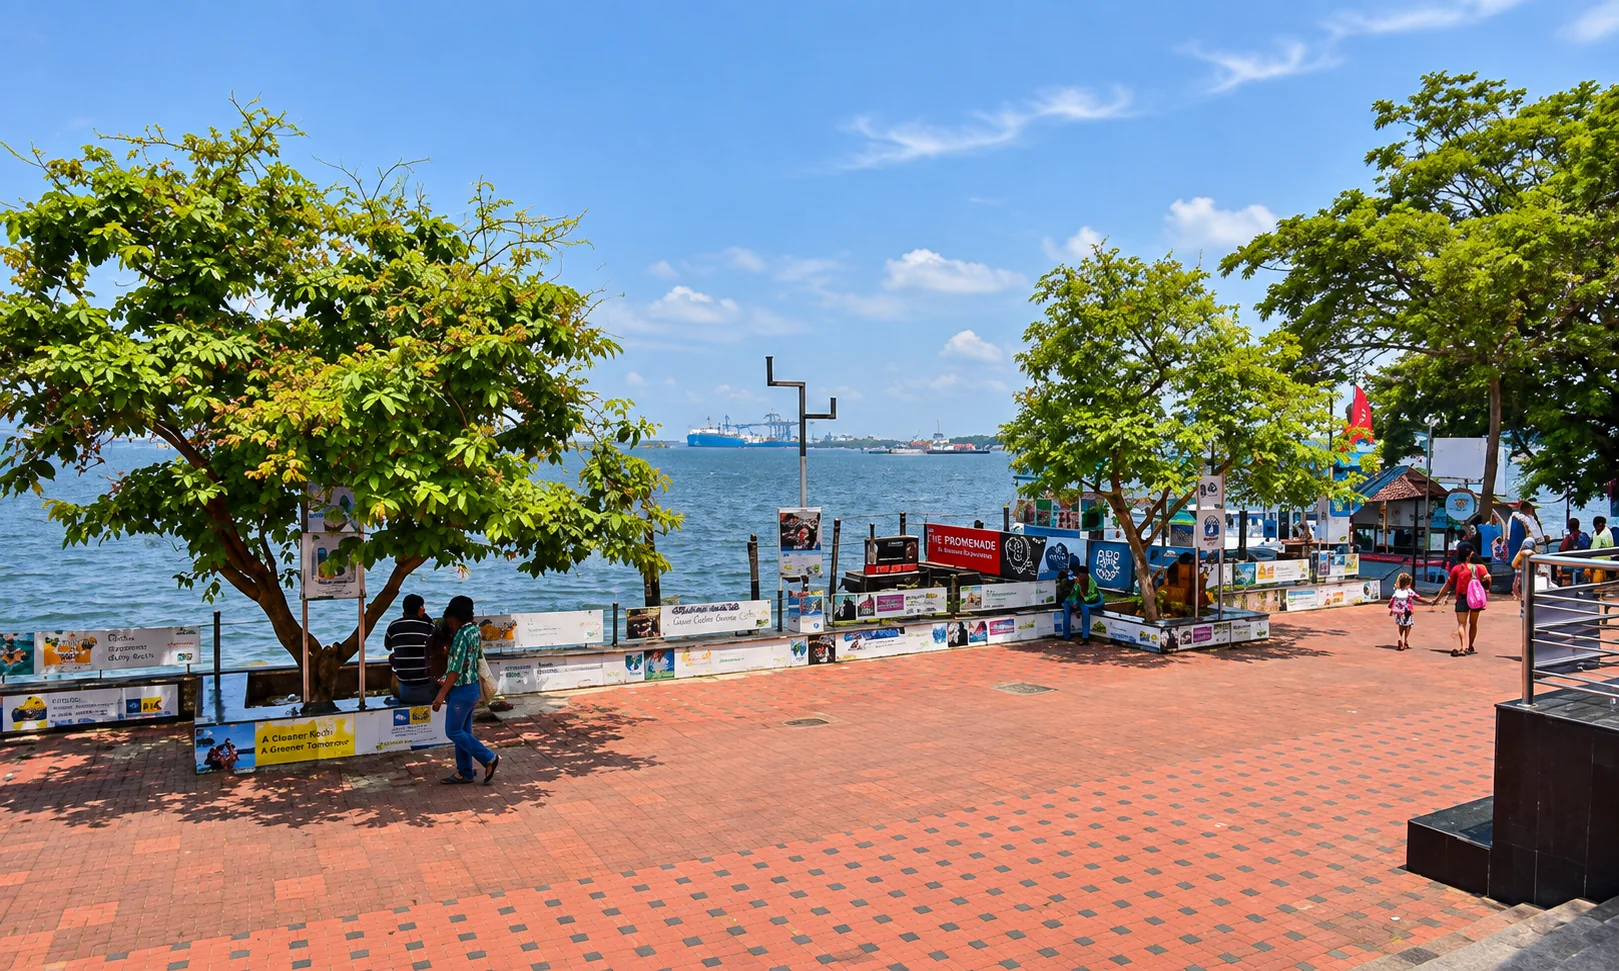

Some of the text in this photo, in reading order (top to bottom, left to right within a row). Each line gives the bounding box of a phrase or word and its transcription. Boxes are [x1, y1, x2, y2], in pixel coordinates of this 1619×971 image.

[944, 536, 996, 551] PROMENADE
[261, 747, 268, 755] A
[270, 744, 304, 753] Greener
